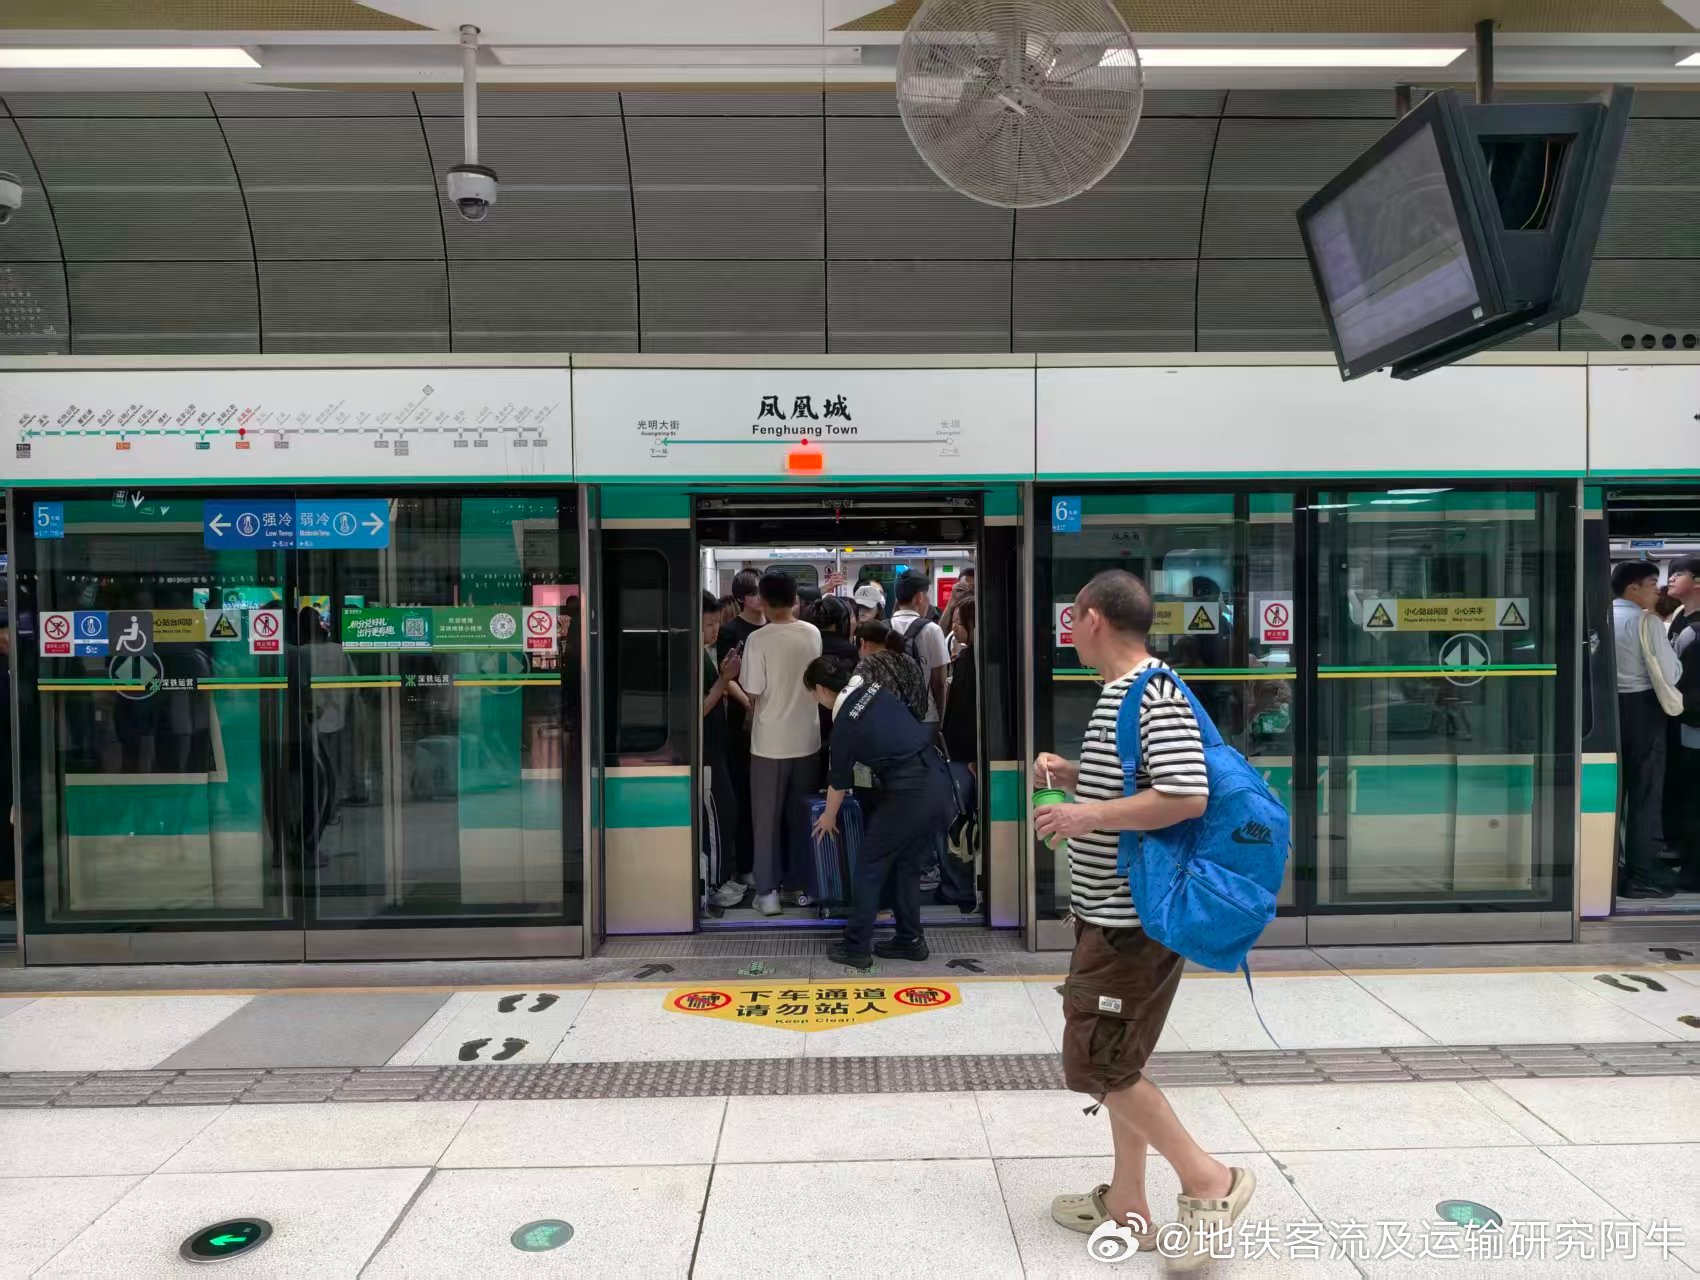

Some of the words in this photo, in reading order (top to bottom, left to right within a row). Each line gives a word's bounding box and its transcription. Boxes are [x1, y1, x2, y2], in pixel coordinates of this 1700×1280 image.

[757, 394, 852, 421] 凤凰城
[637, 419, 680, 430] 光明大街
[752, 424, 822, 437] Fenghuang
[825, 424, 858, 435] Town
[38, 507, 50, 527] 5
[1055, 501, 1068, 521] 6
[262, 512, 293, 527] 强冷
[300, 512, 330, 527] 弱冷
[279, 530, 294, 538] Temp
[153, 618, 193, 627] 心站台间隙
[740, 989, 888, 1002] 下车通道
[736, 1001, 888, 1017] 请勿站人
